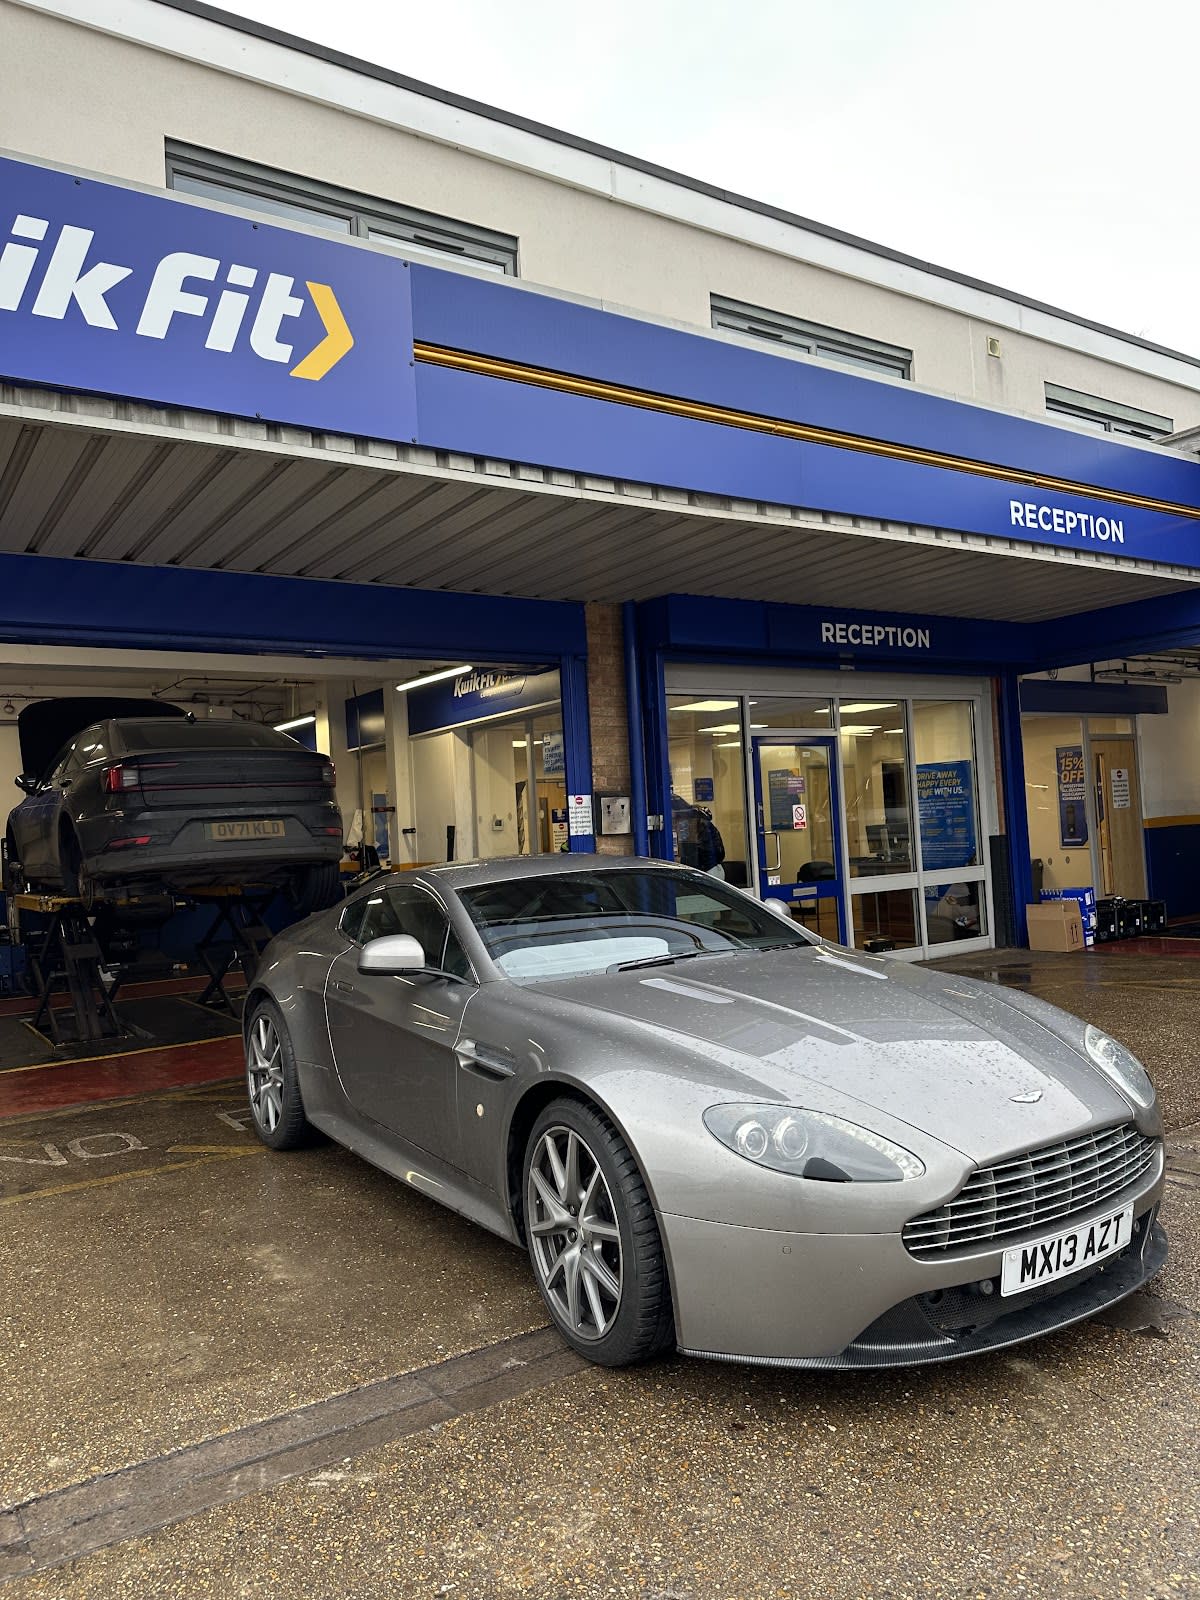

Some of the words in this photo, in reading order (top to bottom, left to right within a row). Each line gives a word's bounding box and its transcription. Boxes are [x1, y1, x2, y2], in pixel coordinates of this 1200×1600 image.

[1009, 499, 1125, 544] RECEPTION
[821, 621, 930, 649] RECEPTION
[1060, 757, 1085, 771] 15%
[917, 772, 936, 781] DRIVE
[936, 770, 957, 779] AWAY
[1061, 770, 1085, 784] OFF
[917, 780, 939, 789] HAPPY
[940, 778, 962, 787] EVERY
[218, 823, 250, 837] OV71
[253, 821, 280, 836] KLD
[1020, 1233, 1079, 1283] MX13
[1083, 1211, 1125, 1261] AZT
